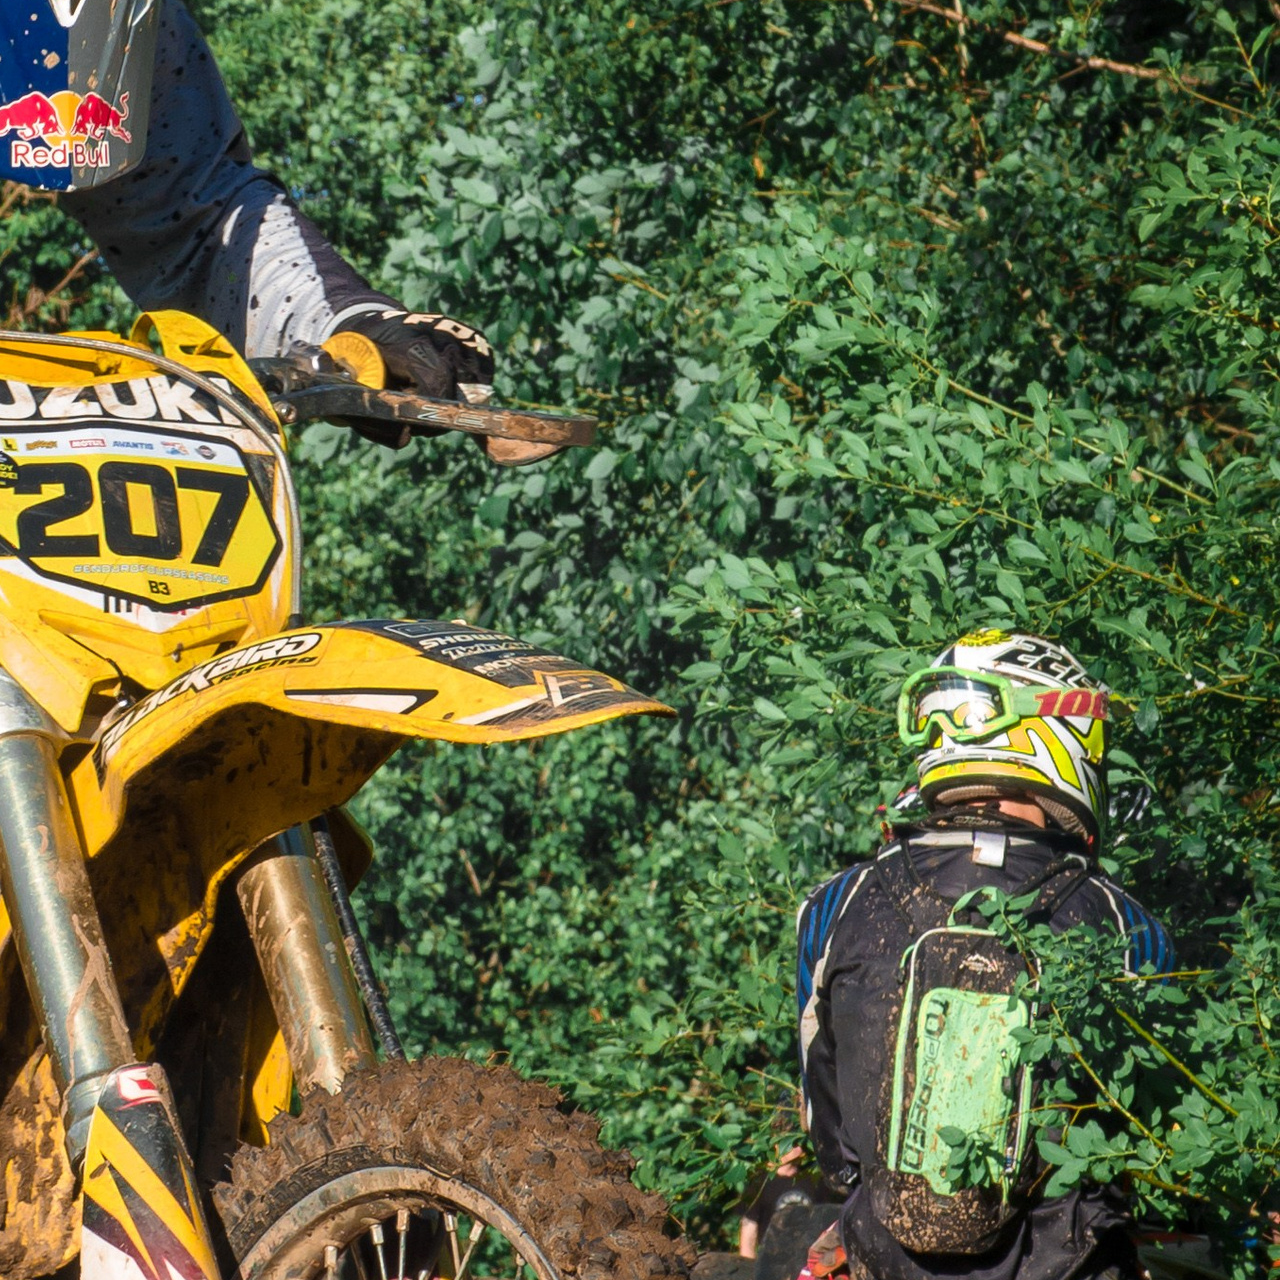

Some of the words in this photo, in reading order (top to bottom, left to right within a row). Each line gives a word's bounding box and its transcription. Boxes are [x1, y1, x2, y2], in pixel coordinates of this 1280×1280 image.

[12, 141, 68, 167] Red
[74, 141, 110, 167] Bull
[15, 460, 250, 567] 207
[73, 563, 231, 585] #ENDUROFOURSEASONS
[148, 579, 171, 596] B3
[217, 655, 319, 684] Racing
